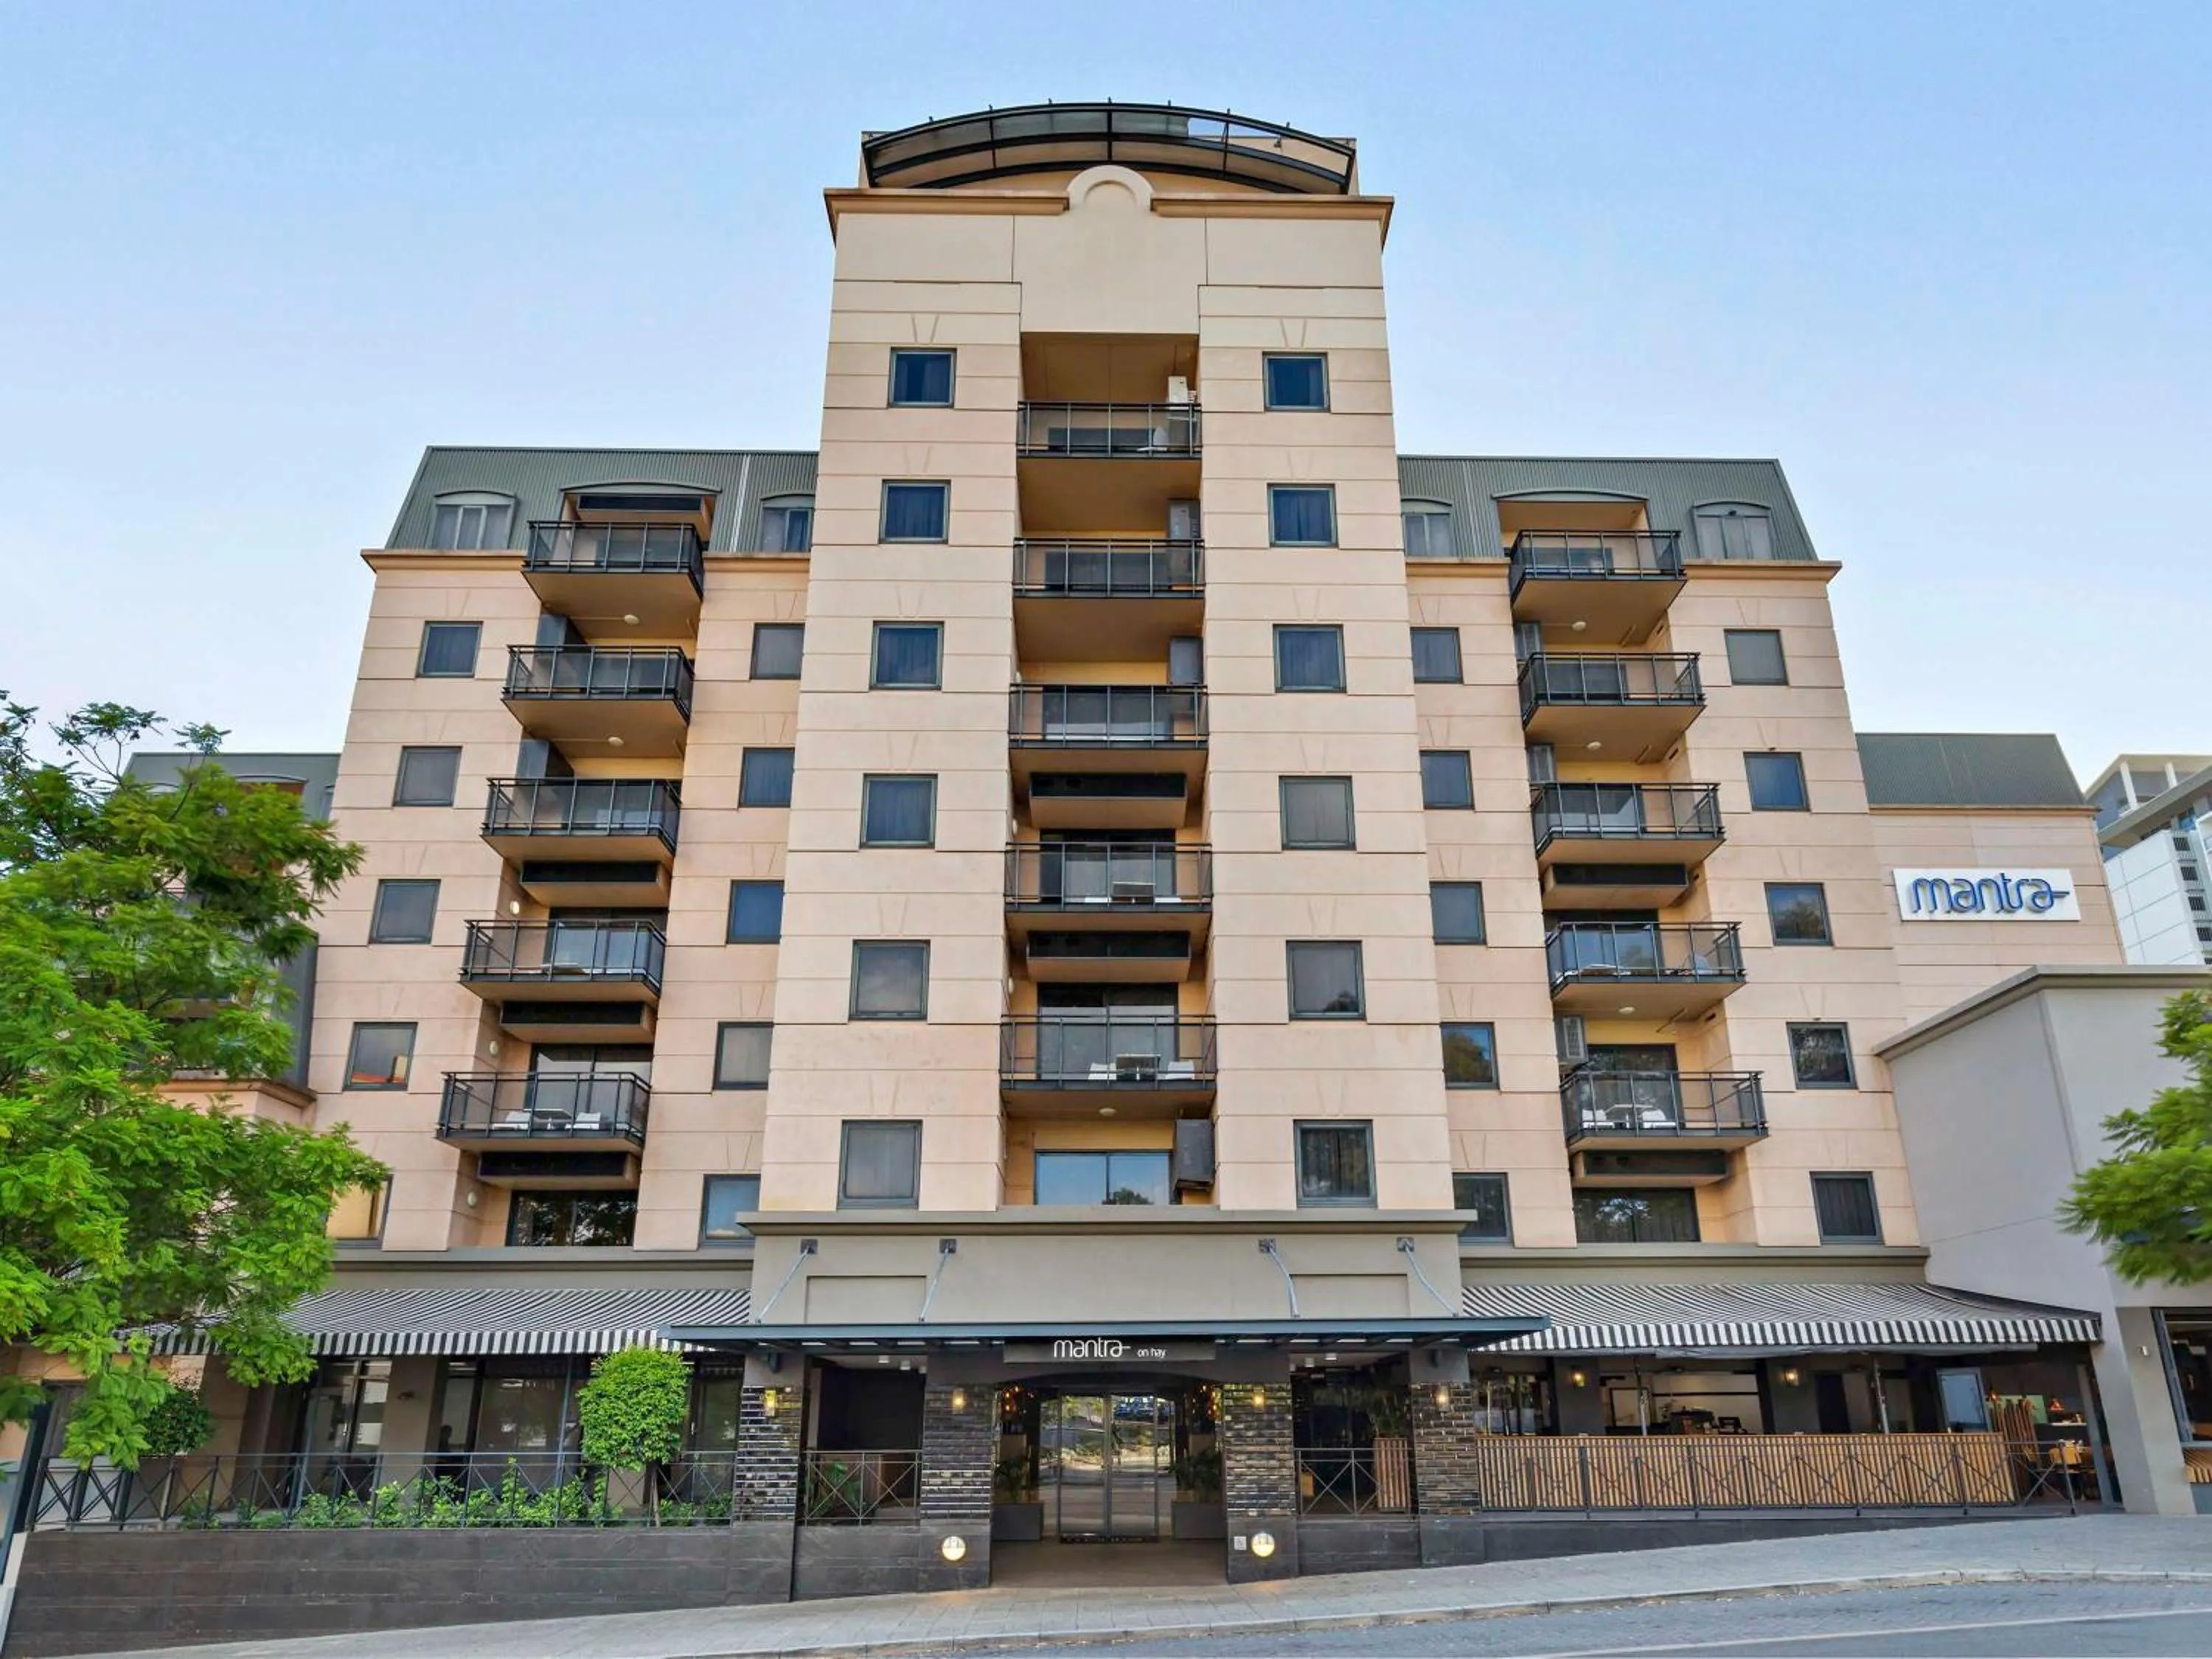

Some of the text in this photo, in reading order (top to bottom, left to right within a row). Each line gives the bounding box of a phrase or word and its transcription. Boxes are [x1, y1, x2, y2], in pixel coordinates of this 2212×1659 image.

[1912, 872, 2070, 914] mantra
[1054, 1337, 1166, 1359] mantra on hay
